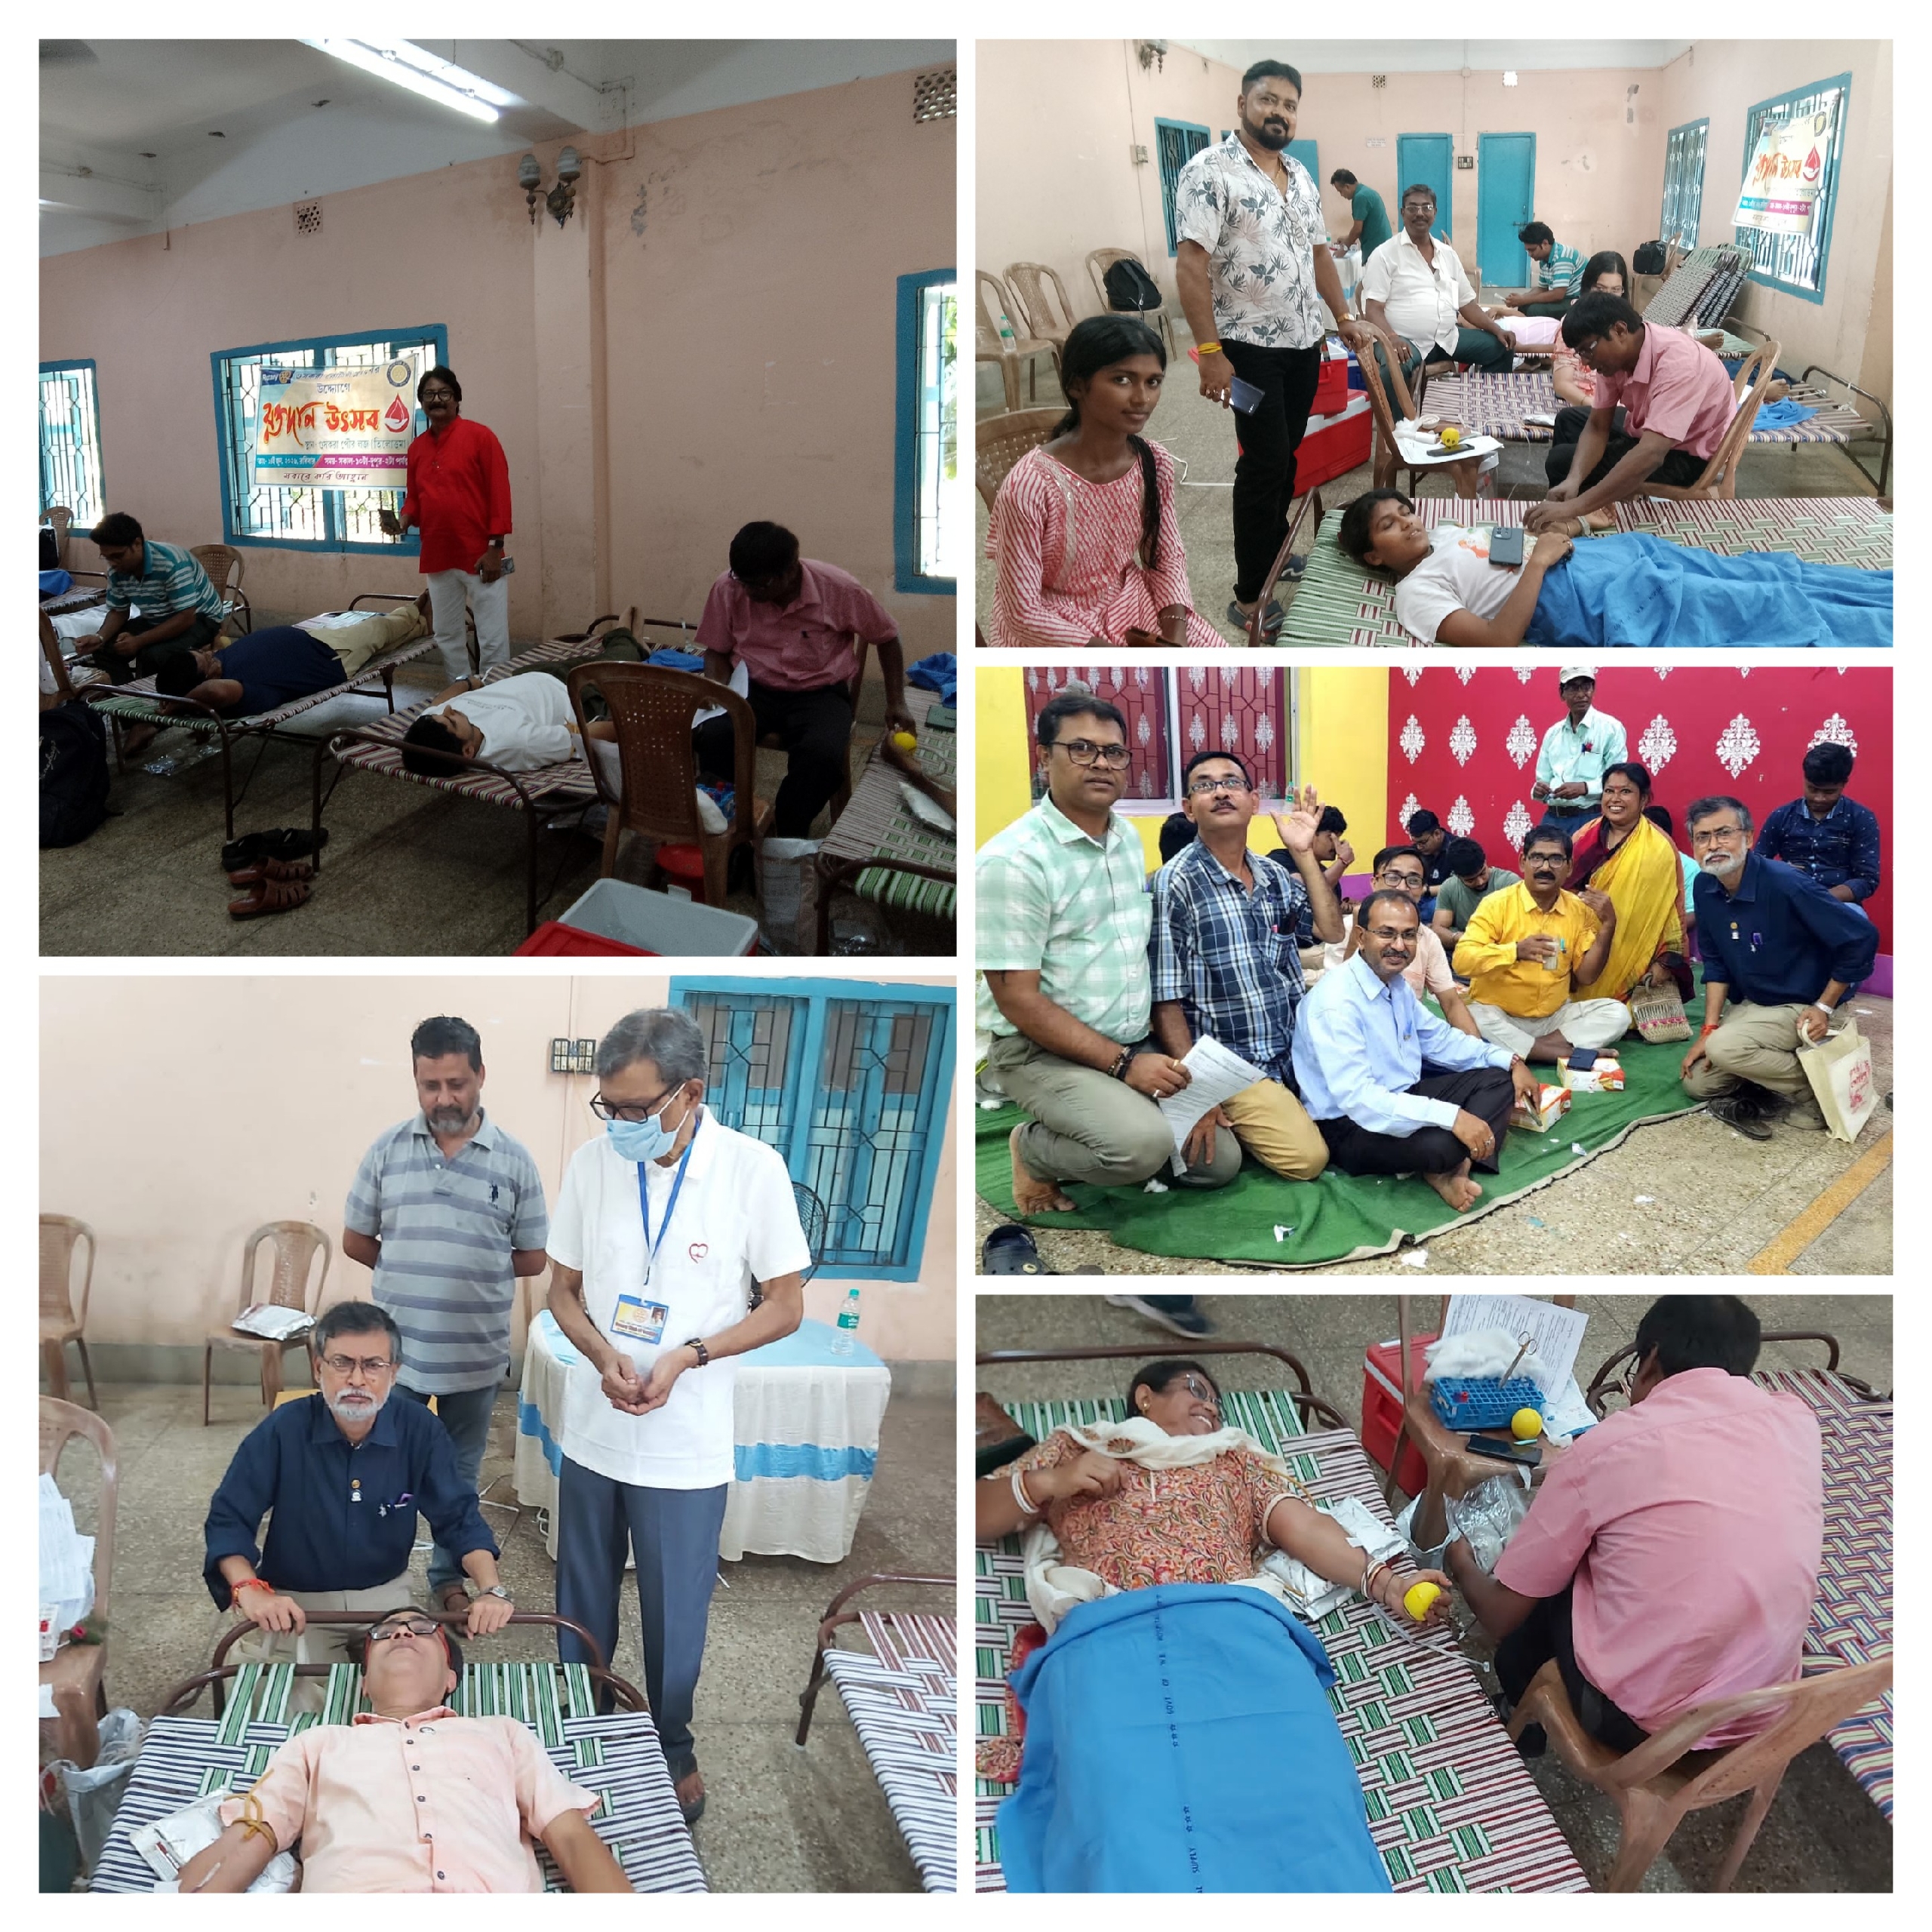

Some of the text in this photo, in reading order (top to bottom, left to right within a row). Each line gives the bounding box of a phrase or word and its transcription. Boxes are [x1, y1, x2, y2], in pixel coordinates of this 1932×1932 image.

[262, 373, 278, 382] Rotary
[263, 401, 380, 446] রক্তদান উৎসব
[314, 469, 335, 481] করি
[1164, 1697, 1175, 1715] GOVT
[1189, 1847, 1201, 1873] SUPPLY
